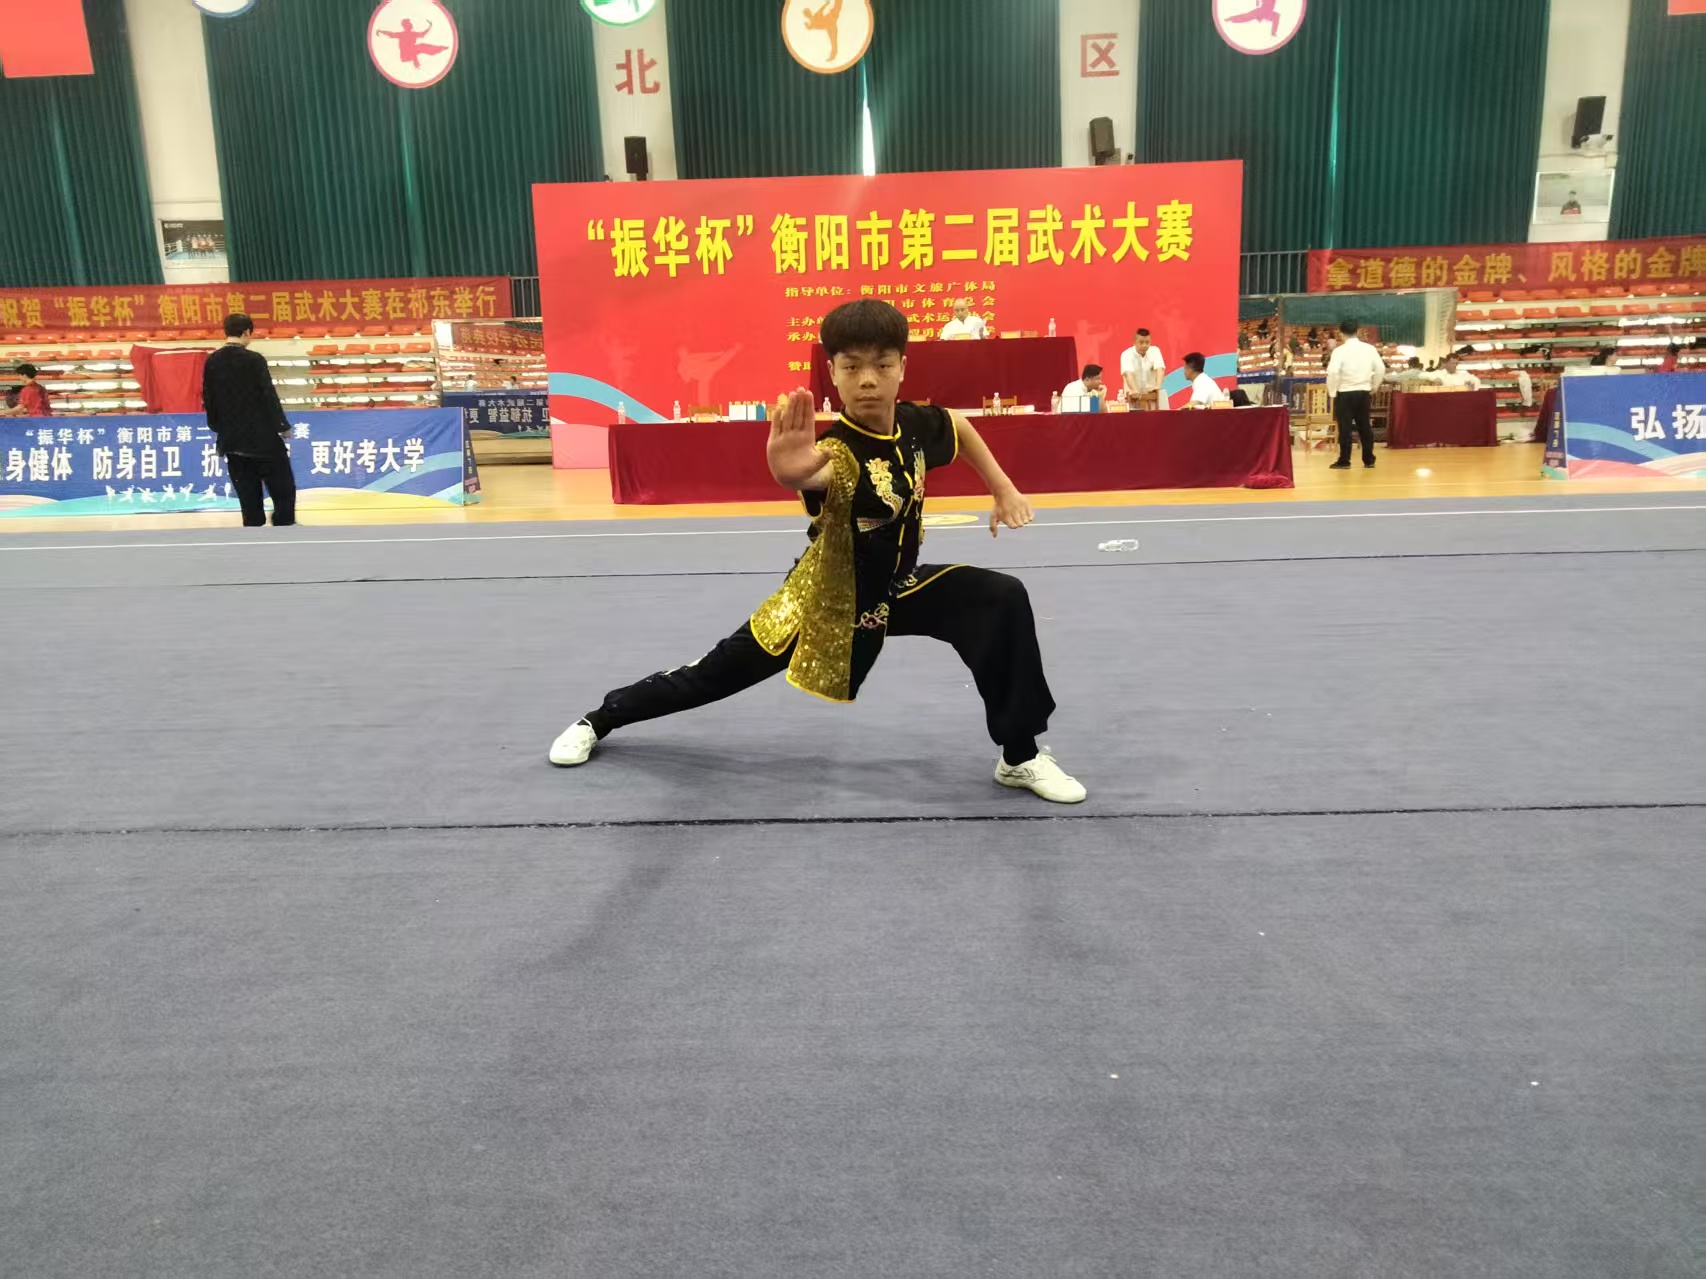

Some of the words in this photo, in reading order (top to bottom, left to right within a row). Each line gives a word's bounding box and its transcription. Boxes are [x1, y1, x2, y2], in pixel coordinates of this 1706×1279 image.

[615, 48, 661, 96] 北
[1081, 32, 1120, 78] 区
[1630, 403, 1706, 442] 弘扬
[0, 446, 73, 482] 身健体
[92, 444, 182, 480] 防身自卫
[310, 437, 425, 475] 更好考大学
